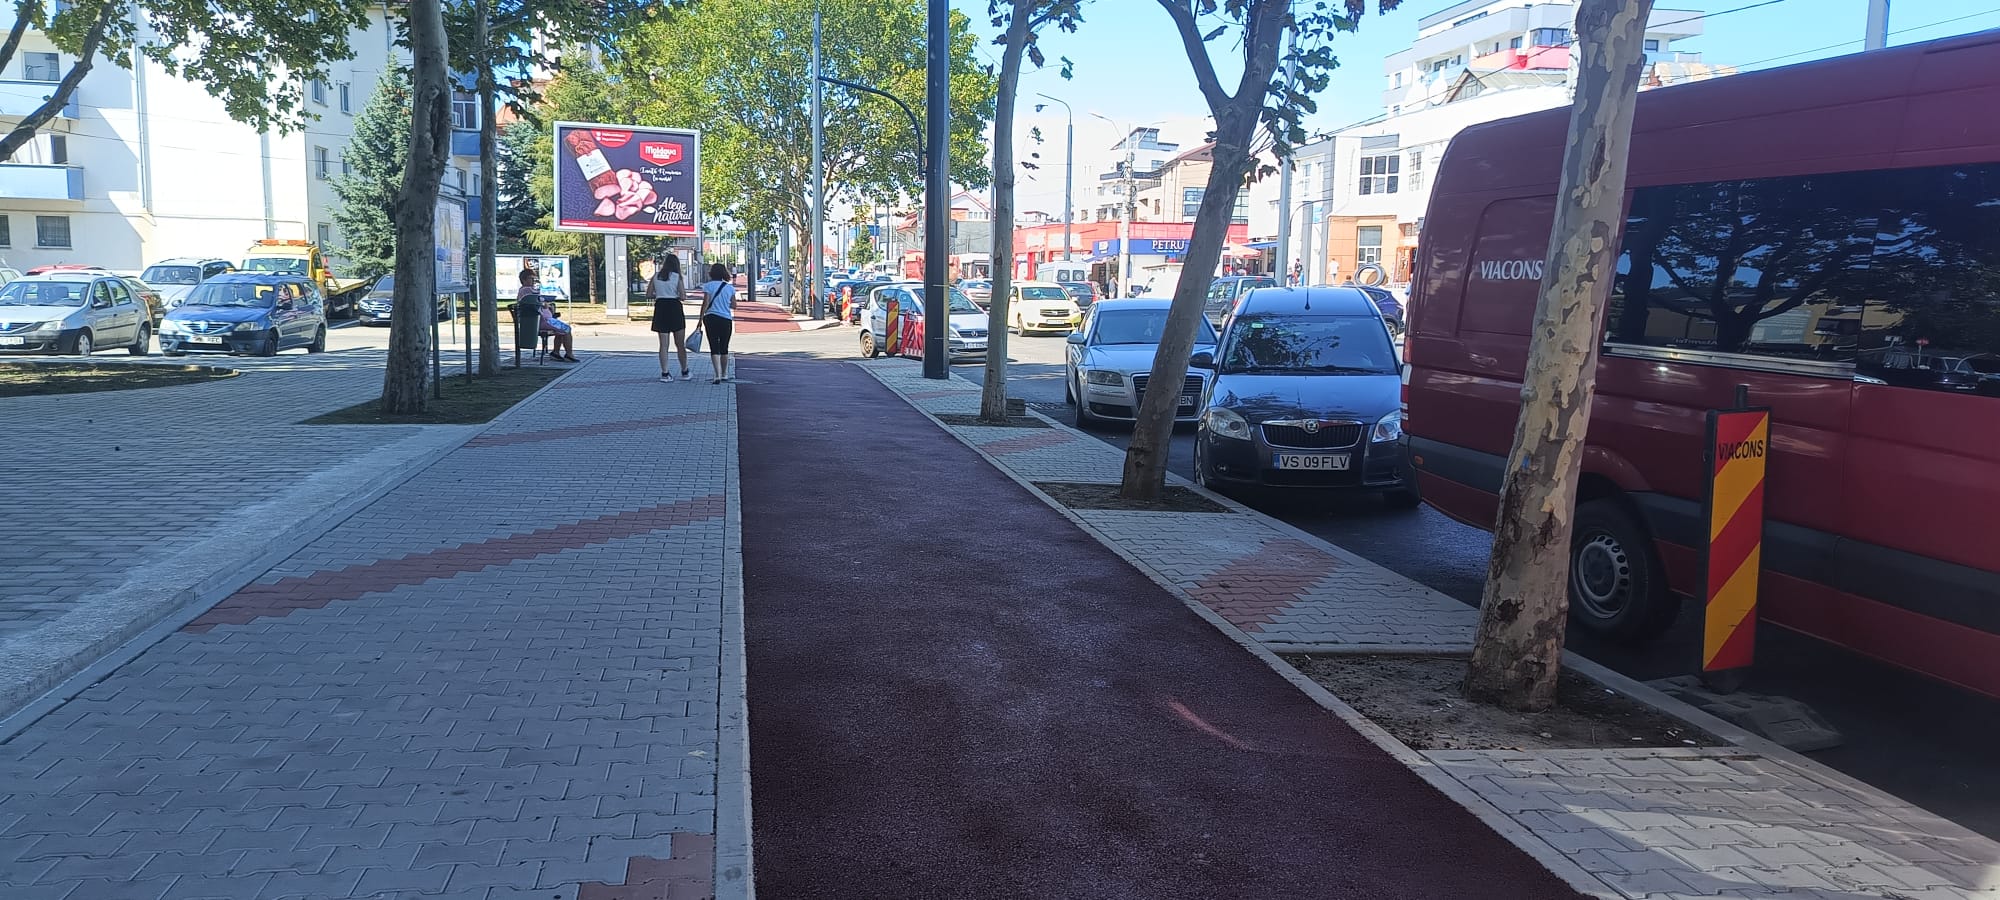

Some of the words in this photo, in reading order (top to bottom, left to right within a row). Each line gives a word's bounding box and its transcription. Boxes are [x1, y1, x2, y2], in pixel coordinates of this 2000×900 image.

[658, 197, 687, 211] Alege
[1152, 240, 1185, 250] PETRU
[1481, 260, 1544, 280] VIACONS
[1719, 440, 1764, 460] VIACONS
[1281, 455, 1300, 468] VS
[1303, 456, 1320, 468] 09
[1321, 456, 1349, 469] FLV
